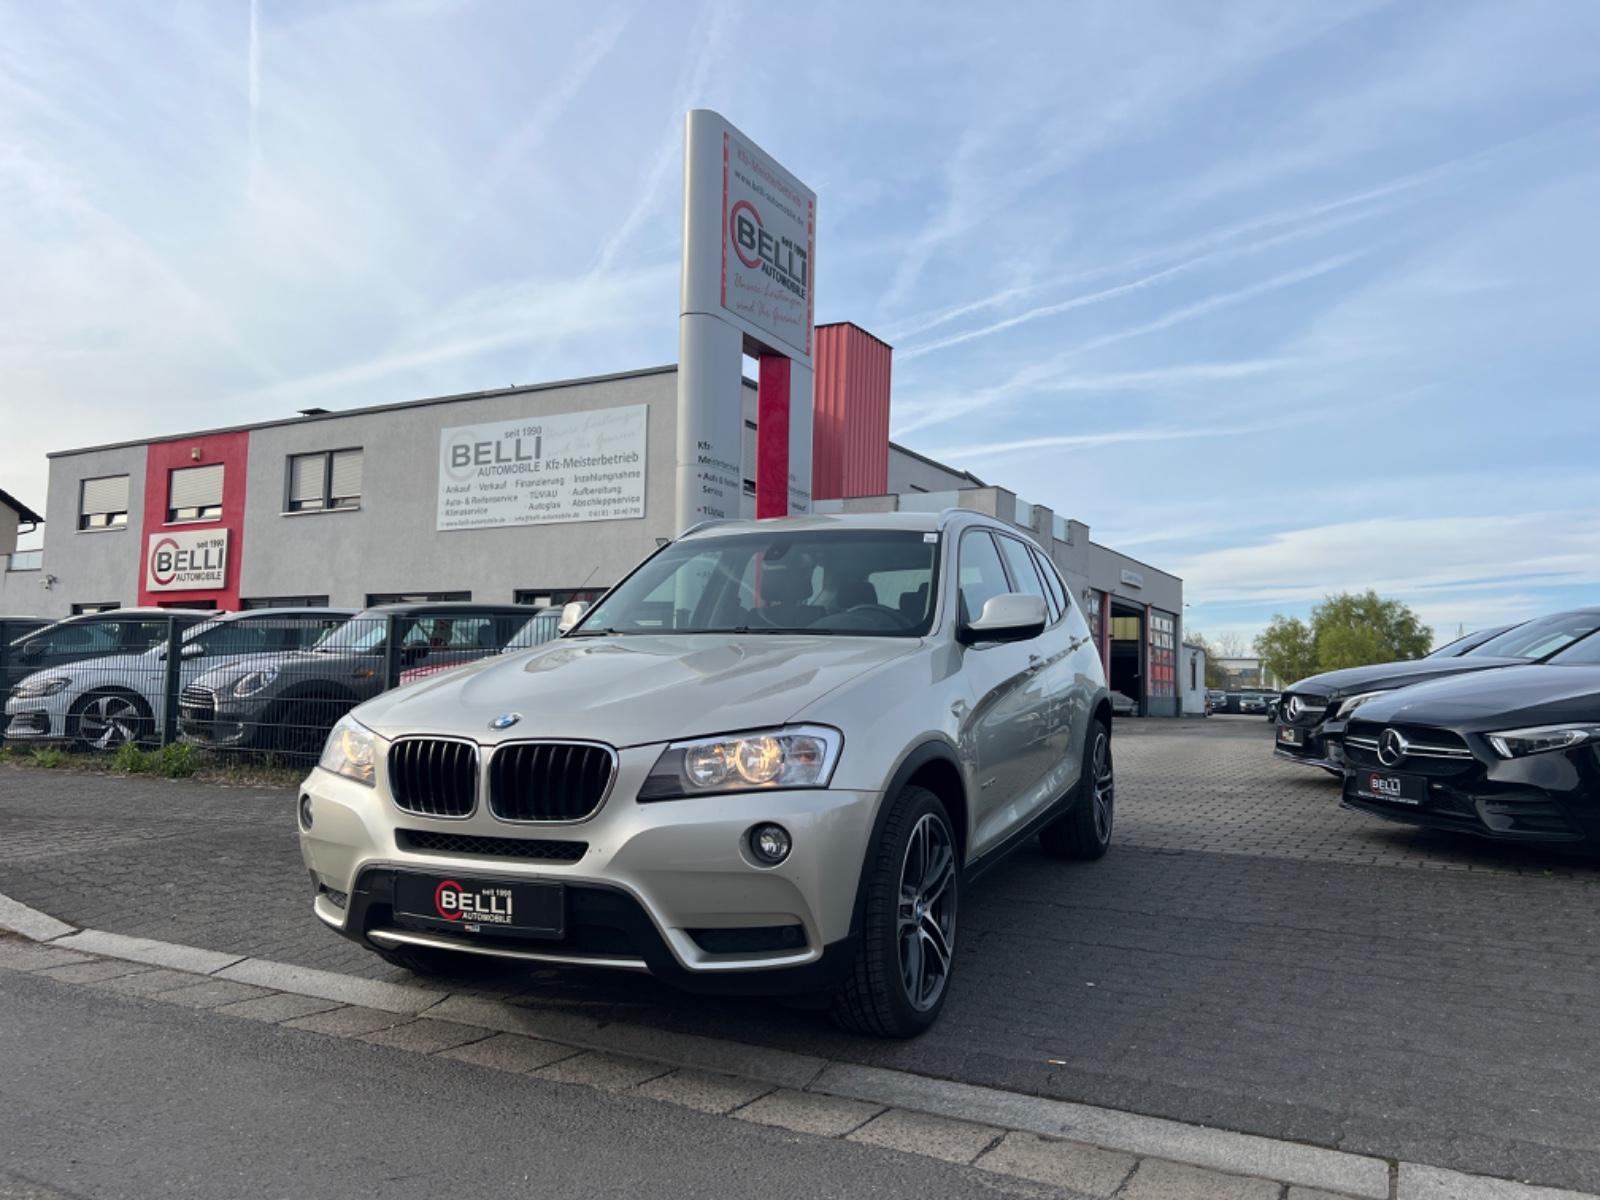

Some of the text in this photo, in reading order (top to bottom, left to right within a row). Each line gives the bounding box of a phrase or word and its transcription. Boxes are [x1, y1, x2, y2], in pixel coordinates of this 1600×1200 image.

[737, 214, 807, 288] BELLI
[761, 262, 806, 300] AUTOMOBILE
[505, 425, 542, 439] seit 1990
[451, 435, 542, 468] BELLI
[545, 451, 639, 471] Kfz-Meisterbetrieb
[477, 461, 541, 478] AUTOMOBILE
[445, 470, 641, 494] Ankauf Verkauf Finanzierung Inzahlungnahme
[572, 485, 622, 496] Aufbereitung
[445, 495, 641, 517] Klimaservice Autoglas Abschleppservice
[157, 547, 224, 573] BELLI
[176, 571, 222, 581] AUTOMOBILE
[441, 889, 513, 915] BELLI
[461, 911, 513, 924] AUTOMOBILE
